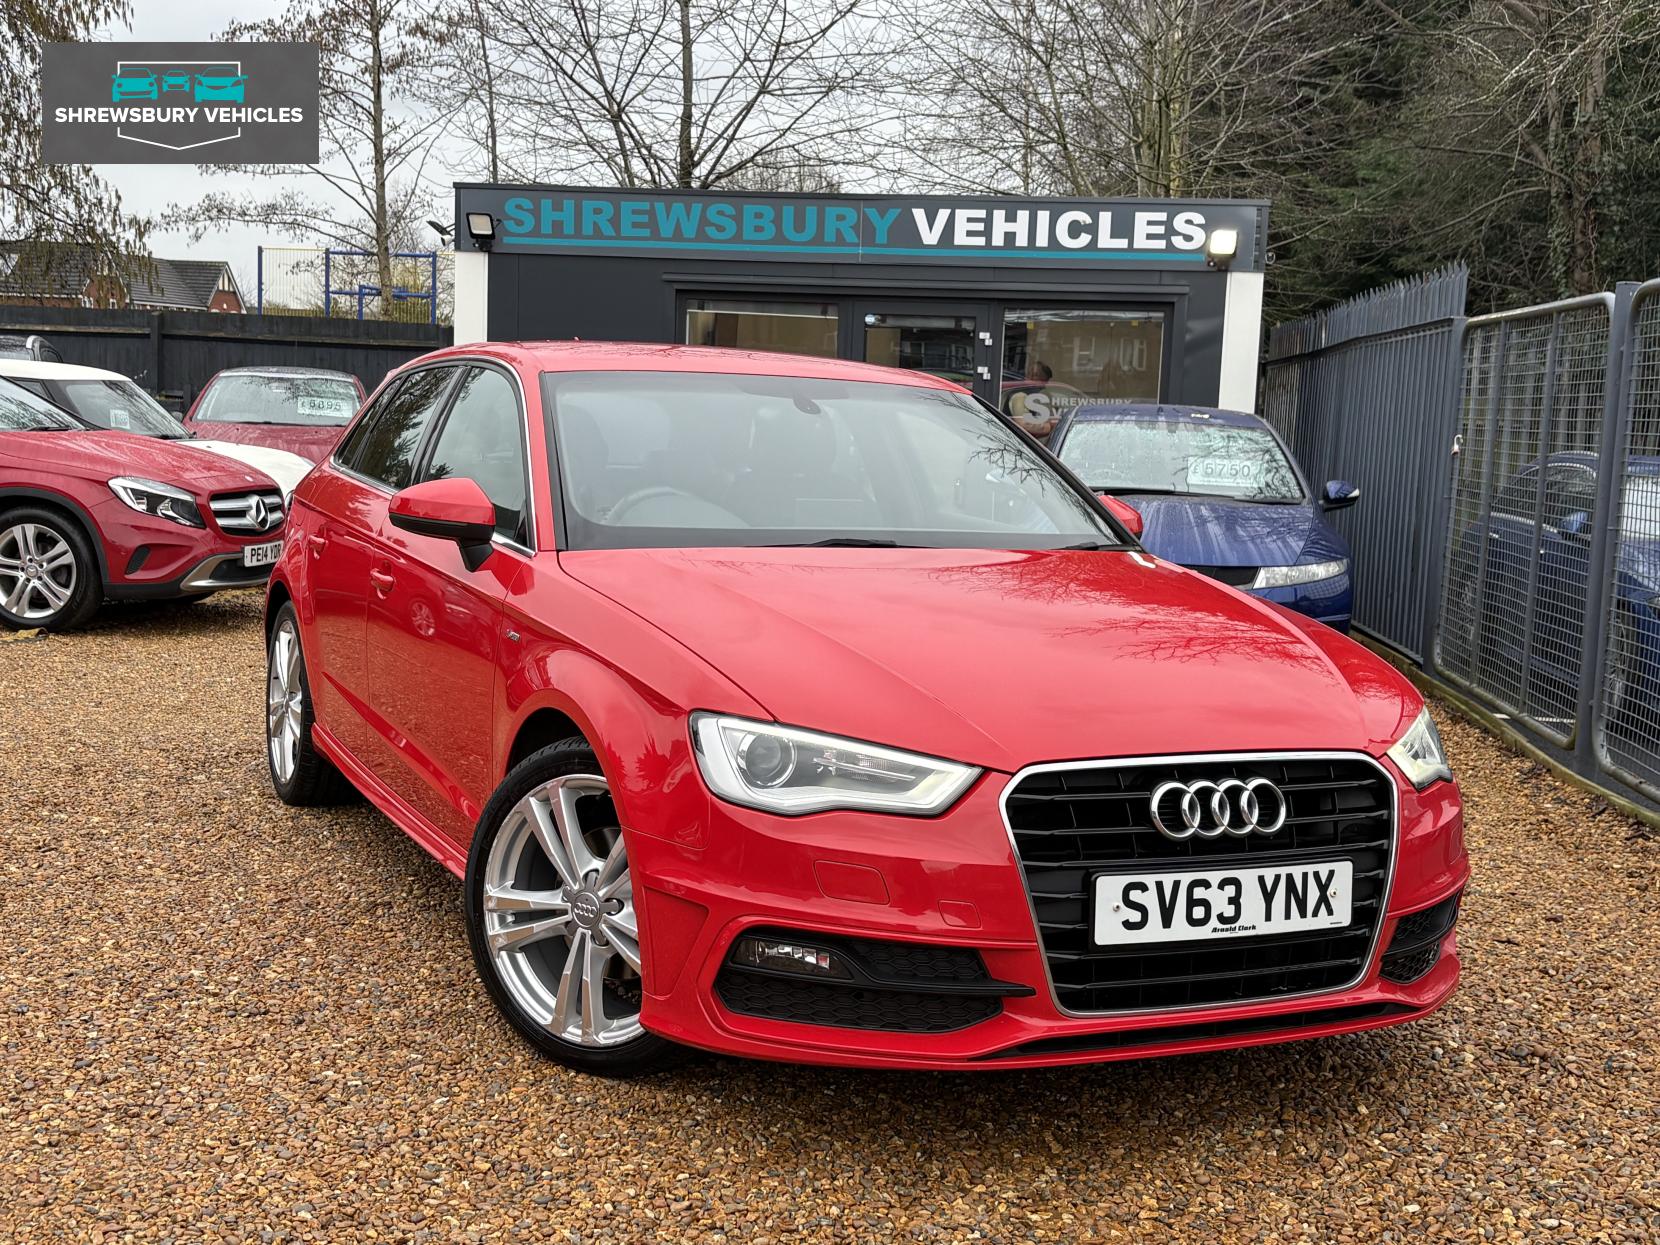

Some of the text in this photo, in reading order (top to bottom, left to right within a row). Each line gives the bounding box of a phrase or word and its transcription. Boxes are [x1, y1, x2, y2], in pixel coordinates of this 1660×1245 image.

[503, 197, 1206, 250] SHREWSBURY VEHICLES
[250, 546, 268, 563] PE14
[1121, 869, 1336, 931] SV63 YNX
